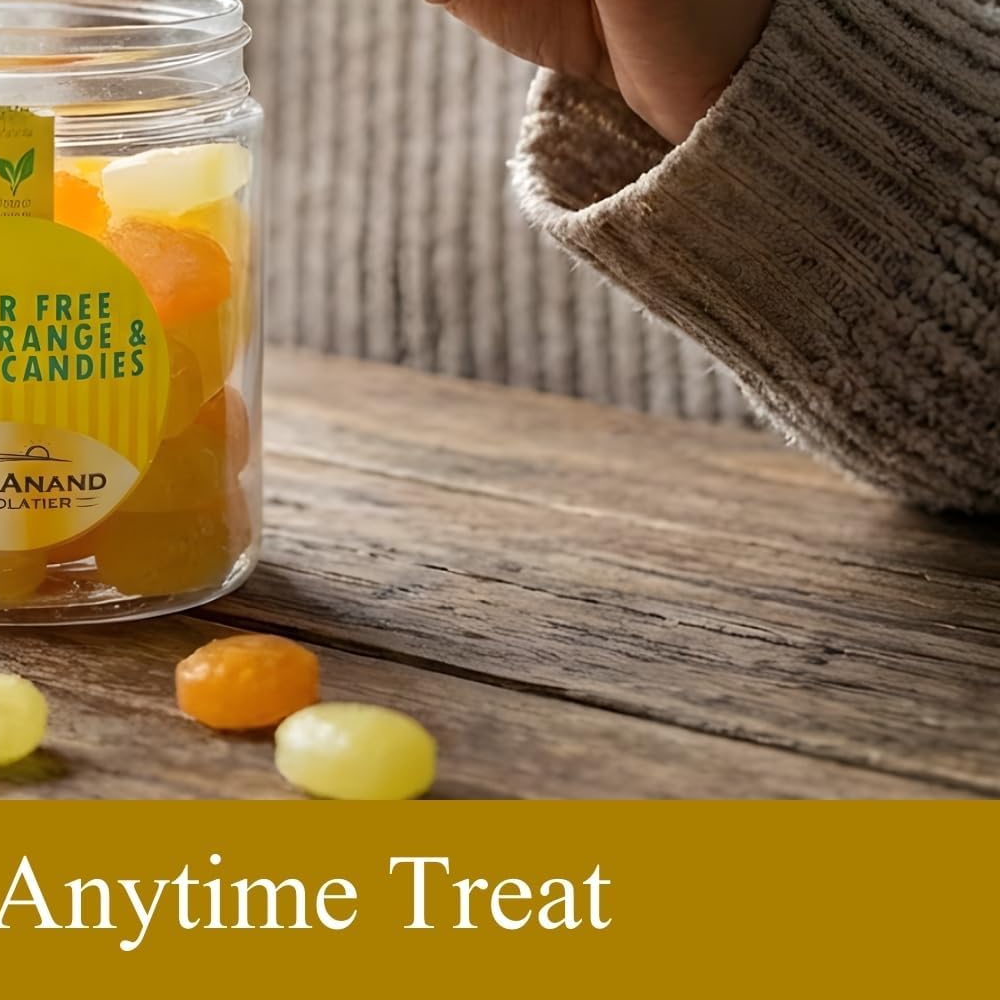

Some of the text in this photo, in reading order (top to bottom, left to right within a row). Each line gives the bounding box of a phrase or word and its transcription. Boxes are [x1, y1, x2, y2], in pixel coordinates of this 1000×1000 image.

[36, 292, 111, 321] FREE
[128, 319, 147, 348] &
[1, 348, 145, 383] CANDIES
[0, 472, 107, 493] ANAND
